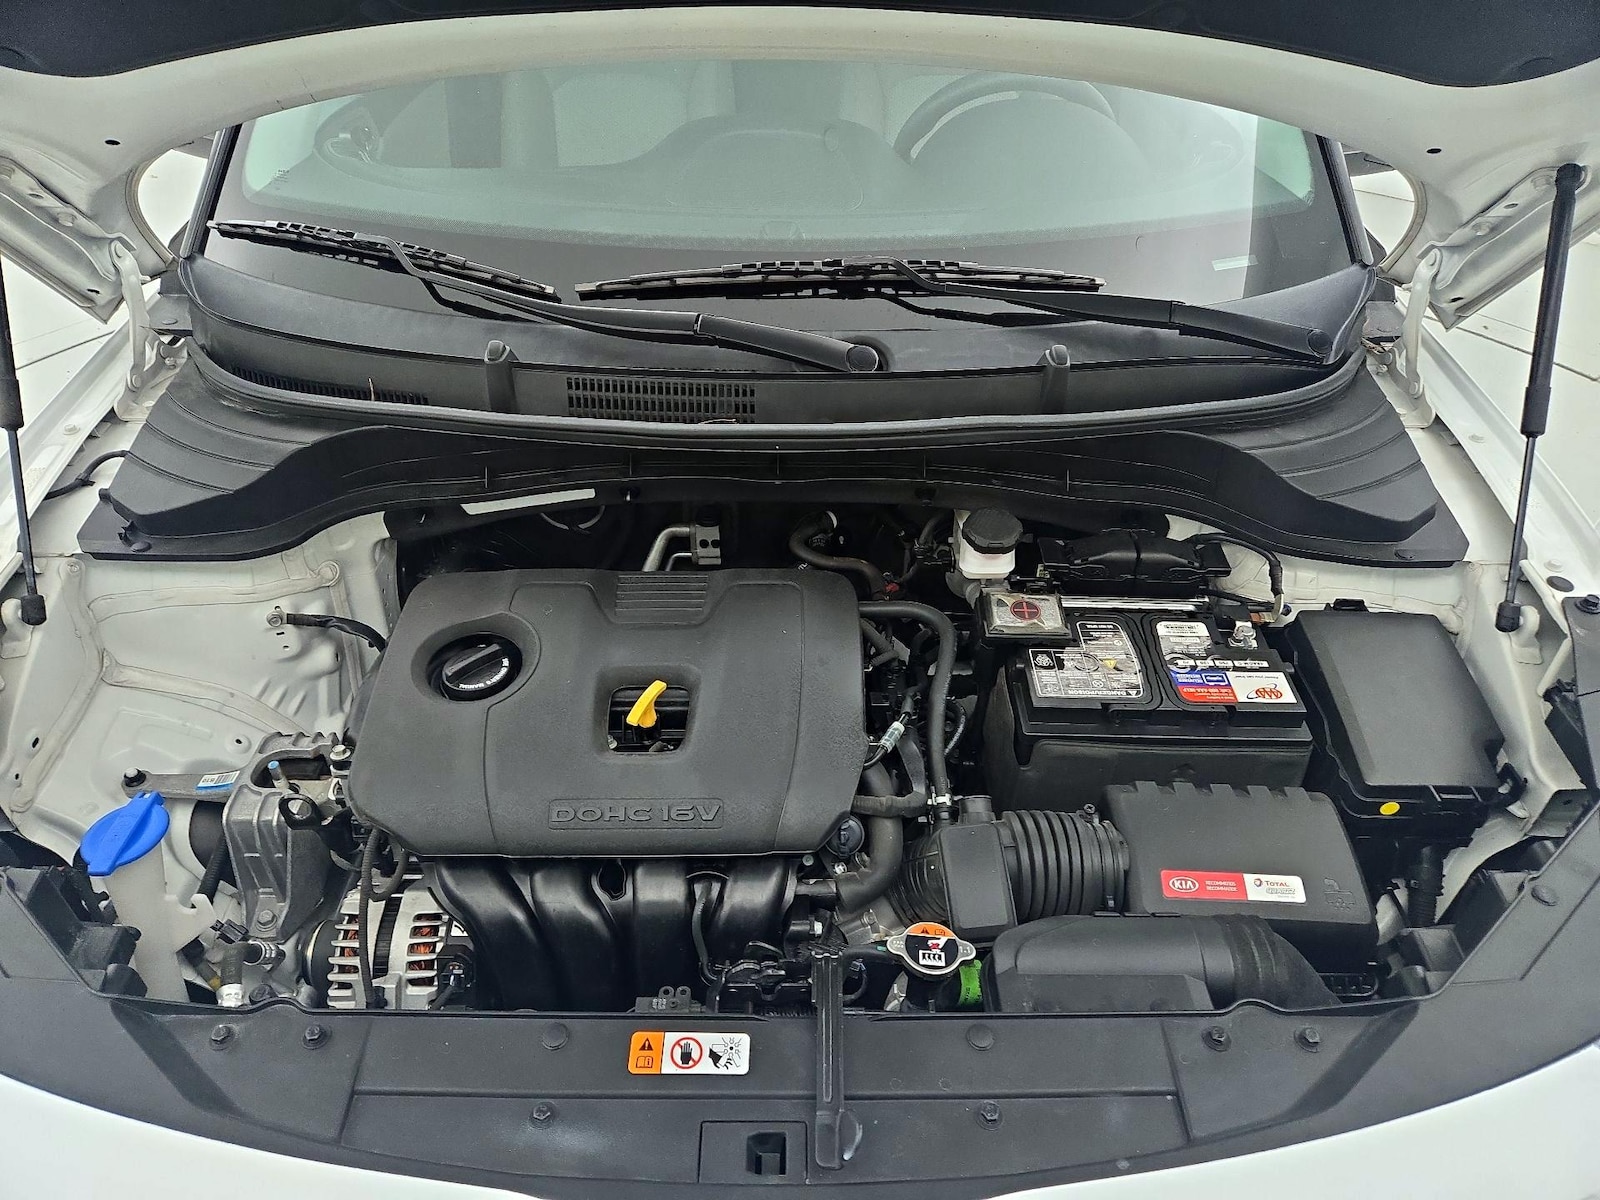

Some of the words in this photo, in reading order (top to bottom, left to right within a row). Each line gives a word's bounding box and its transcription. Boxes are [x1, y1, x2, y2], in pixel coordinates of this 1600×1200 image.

[1257, 688, 1282, 699] AAA
[551, 805, 652, 822] DOHC
[662, 803, 721, 822] 16V
[1174, 879, 1195, 890] KIA
